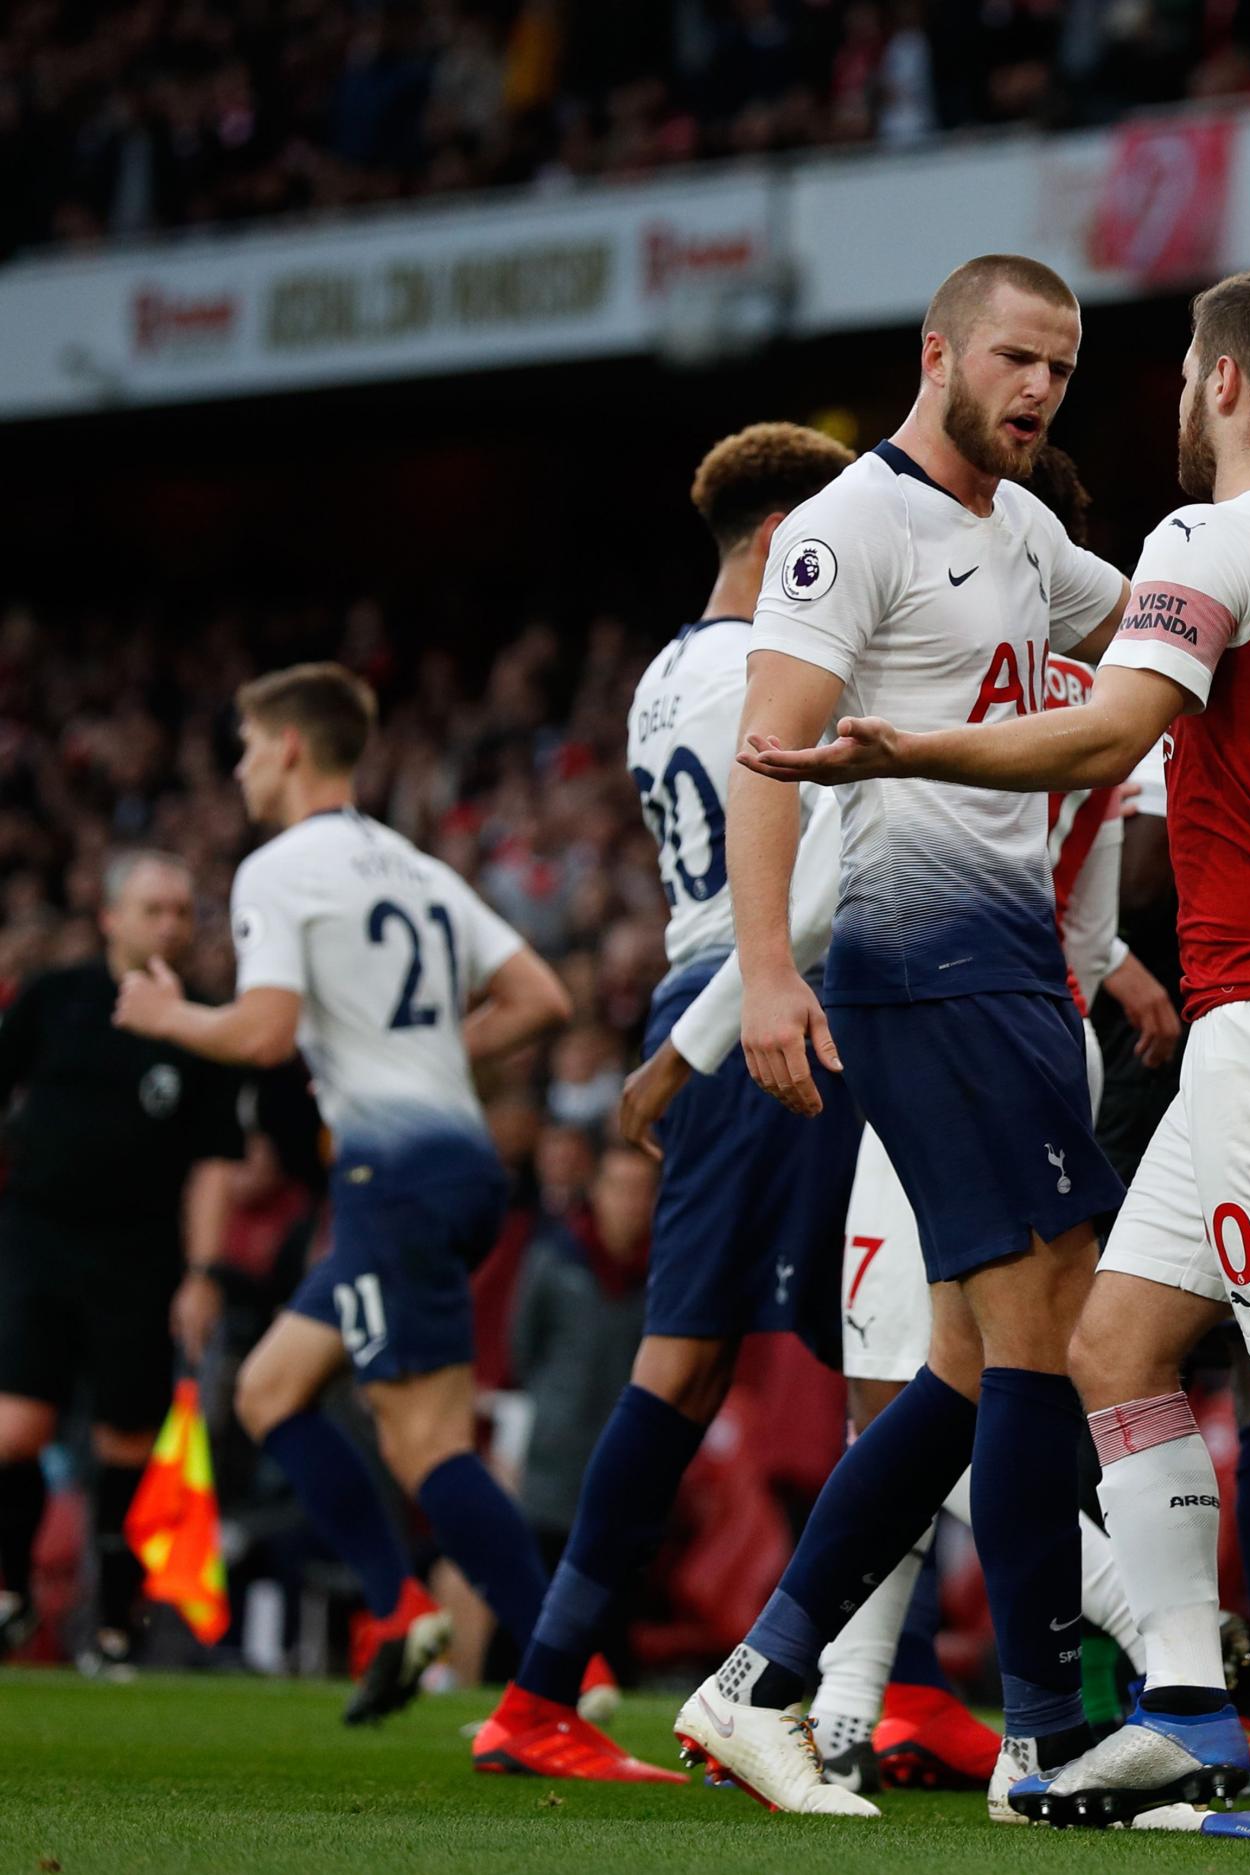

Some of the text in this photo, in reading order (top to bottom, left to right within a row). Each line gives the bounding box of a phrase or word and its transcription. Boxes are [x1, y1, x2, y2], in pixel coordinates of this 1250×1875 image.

[1139, 593, 1187, 615] VISIT
[638, 695, 681, 742] DELE
[367, 899, 460, 1031] 21
[332, 1272, 387, 1350] 21
